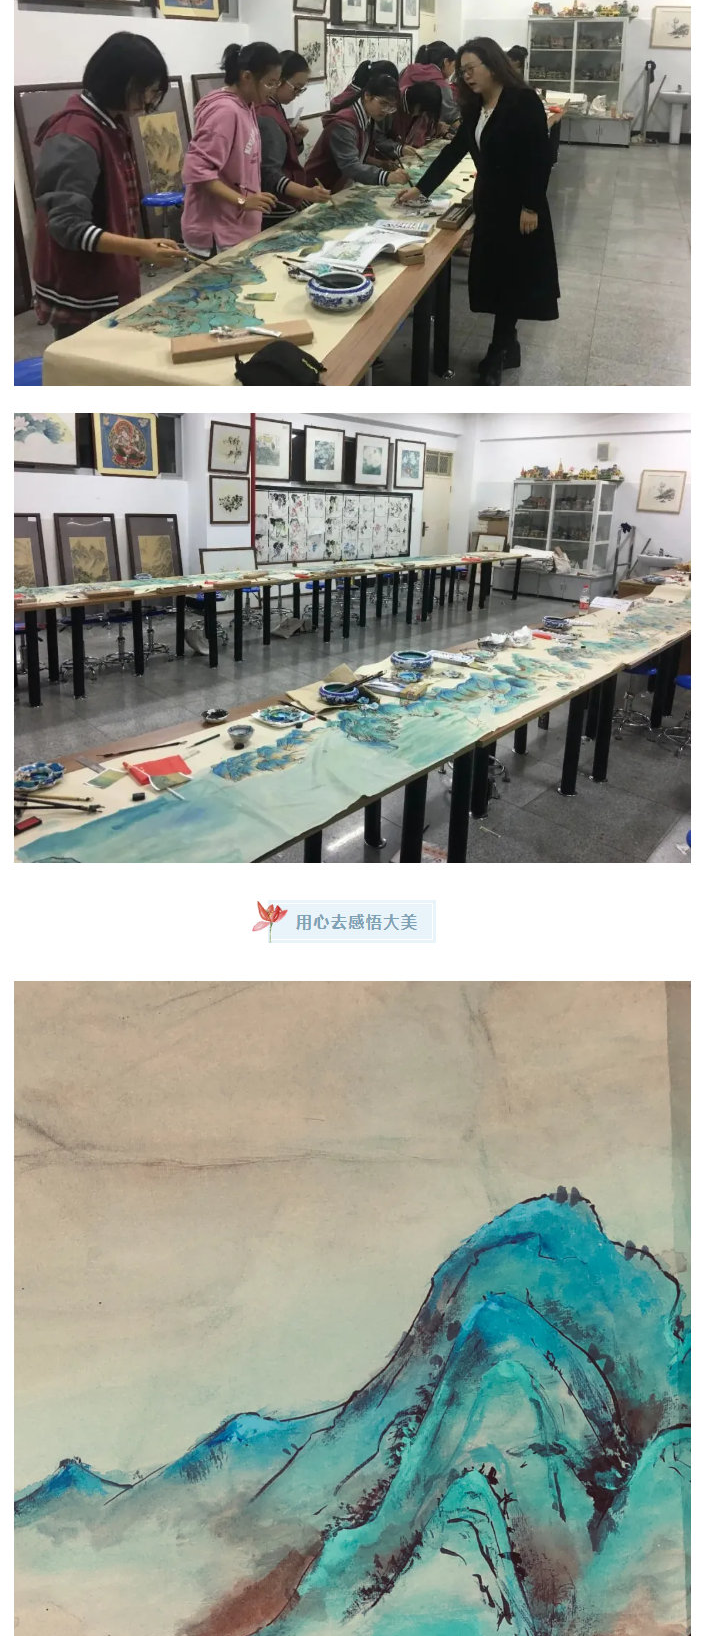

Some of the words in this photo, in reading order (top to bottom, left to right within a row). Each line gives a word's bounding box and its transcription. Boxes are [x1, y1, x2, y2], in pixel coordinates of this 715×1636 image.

[295, 913, 418, 931] 用心去感悟大美
